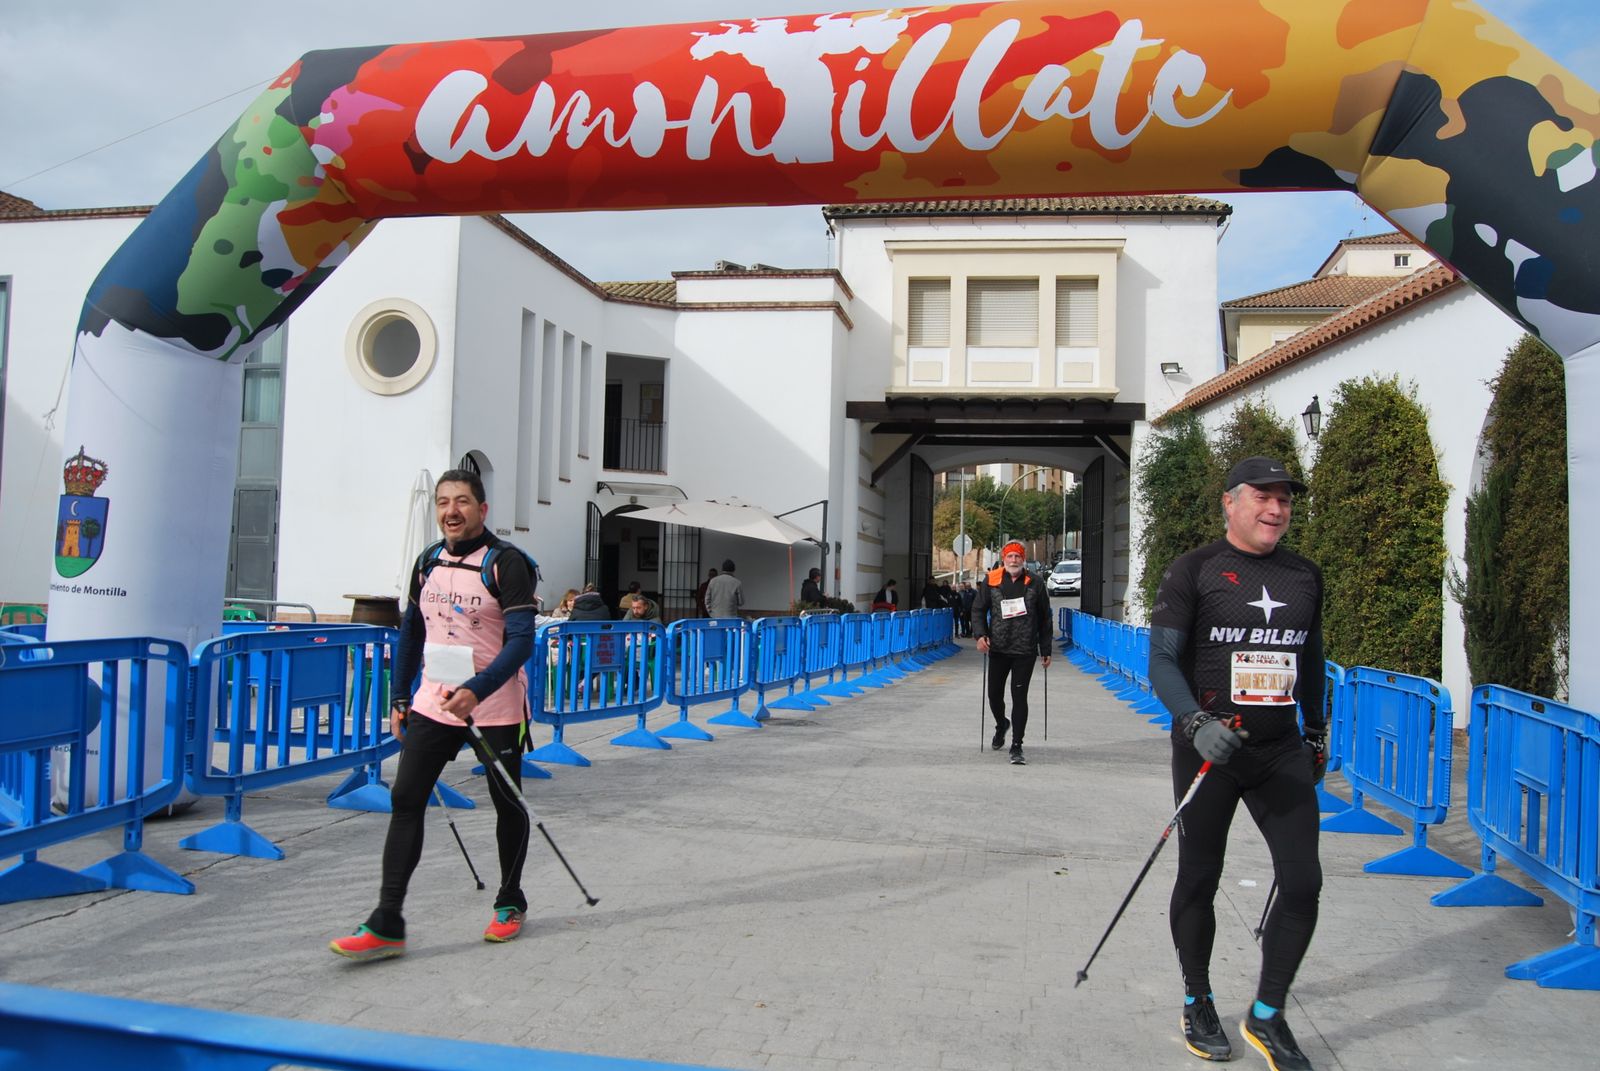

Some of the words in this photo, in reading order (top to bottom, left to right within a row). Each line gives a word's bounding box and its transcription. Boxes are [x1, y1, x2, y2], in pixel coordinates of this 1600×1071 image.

[71, 584, 82, 593] de
[83, 585, 127, 597] Montilla
[1209, 627, 1247, 643] NW
[1248, 628, 1309, 645] BILBAO
